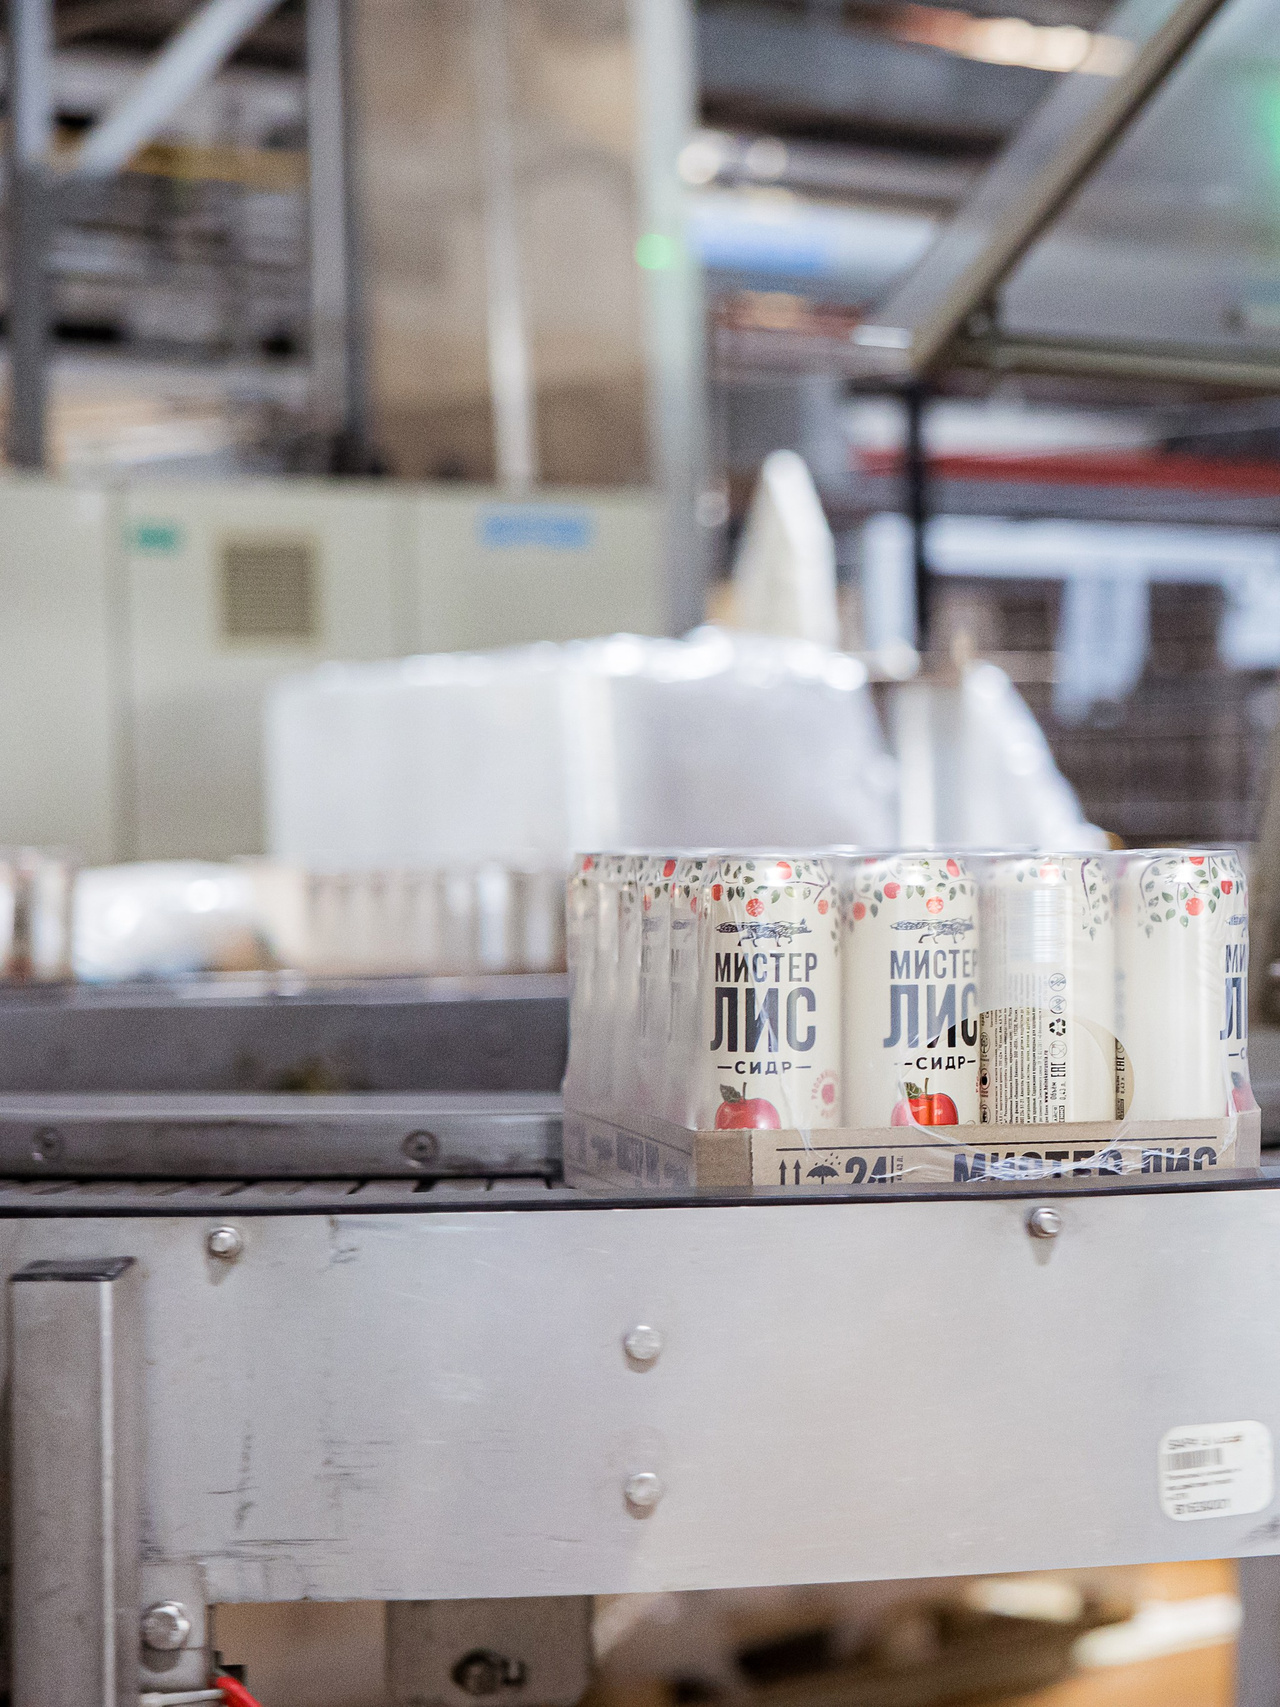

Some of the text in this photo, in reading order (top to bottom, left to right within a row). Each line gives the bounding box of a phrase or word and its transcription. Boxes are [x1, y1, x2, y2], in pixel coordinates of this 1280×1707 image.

[715, 952, 818, 983] МИСТЕР
[710, 986, 816, 1052] ЛИС
[883, 982, 978, 1048] ЛИС
[734, 1060, 793, 1075] СИДР
[915, 1056, 966, 1071] СИДР
[845, 1156, 887, 1184] 24
